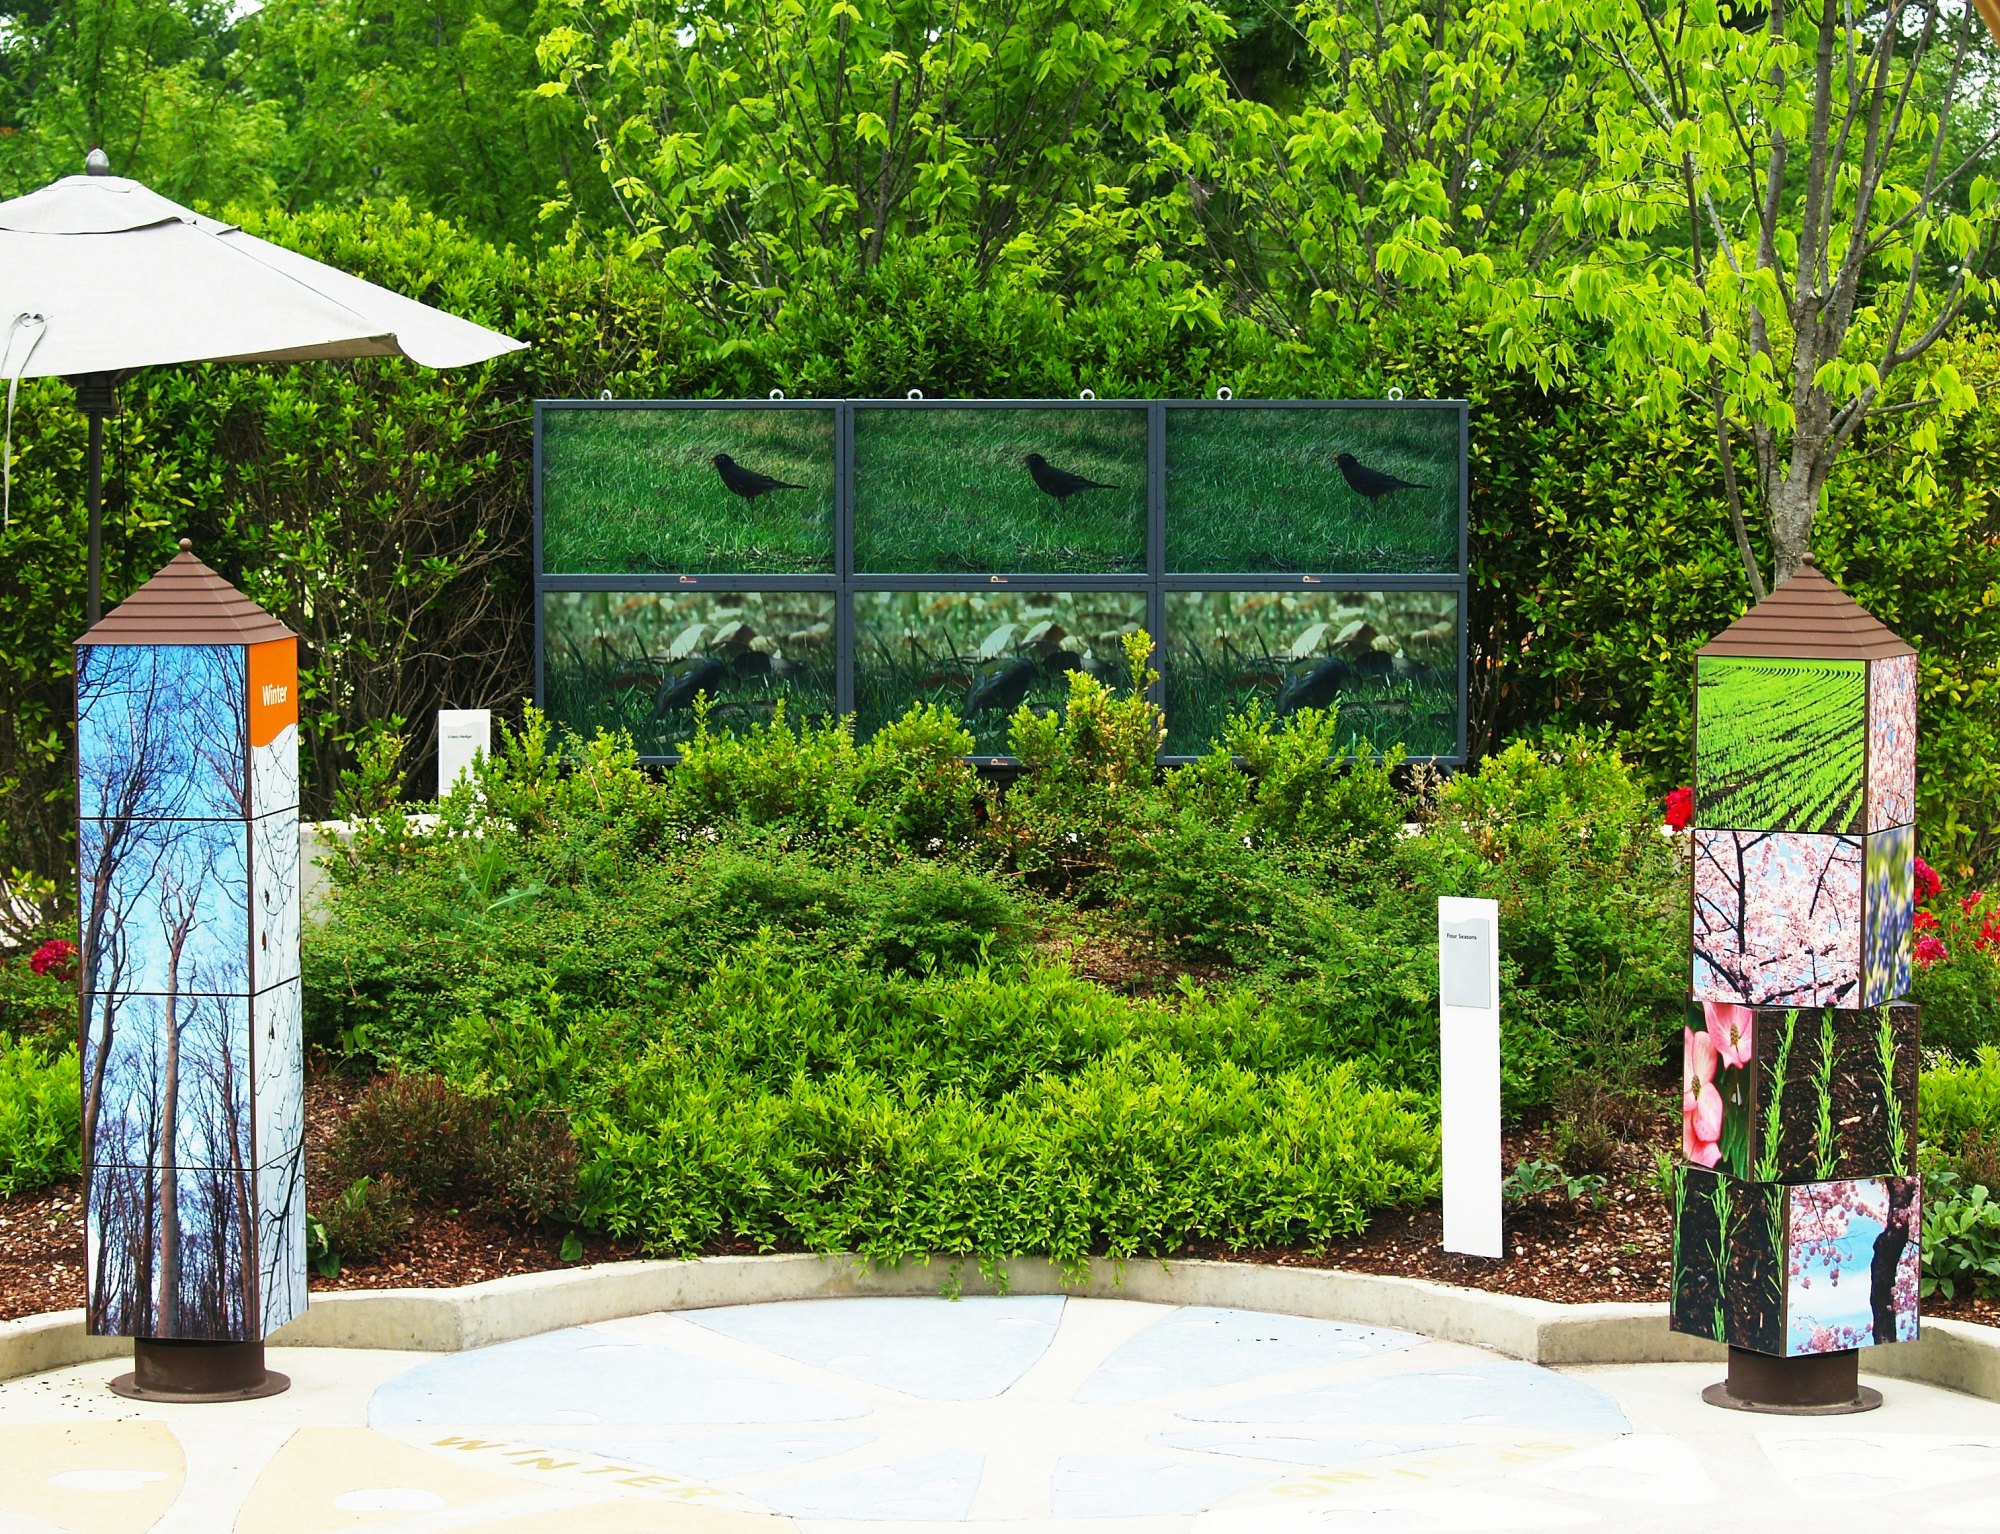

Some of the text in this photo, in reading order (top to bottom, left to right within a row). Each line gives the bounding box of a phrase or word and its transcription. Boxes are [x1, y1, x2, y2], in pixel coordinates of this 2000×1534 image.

[262, 683, 288, 707] Winter
[1458, 933, 1478, 941] Seasons
[430, 1436, 722, 1499] WINTER
